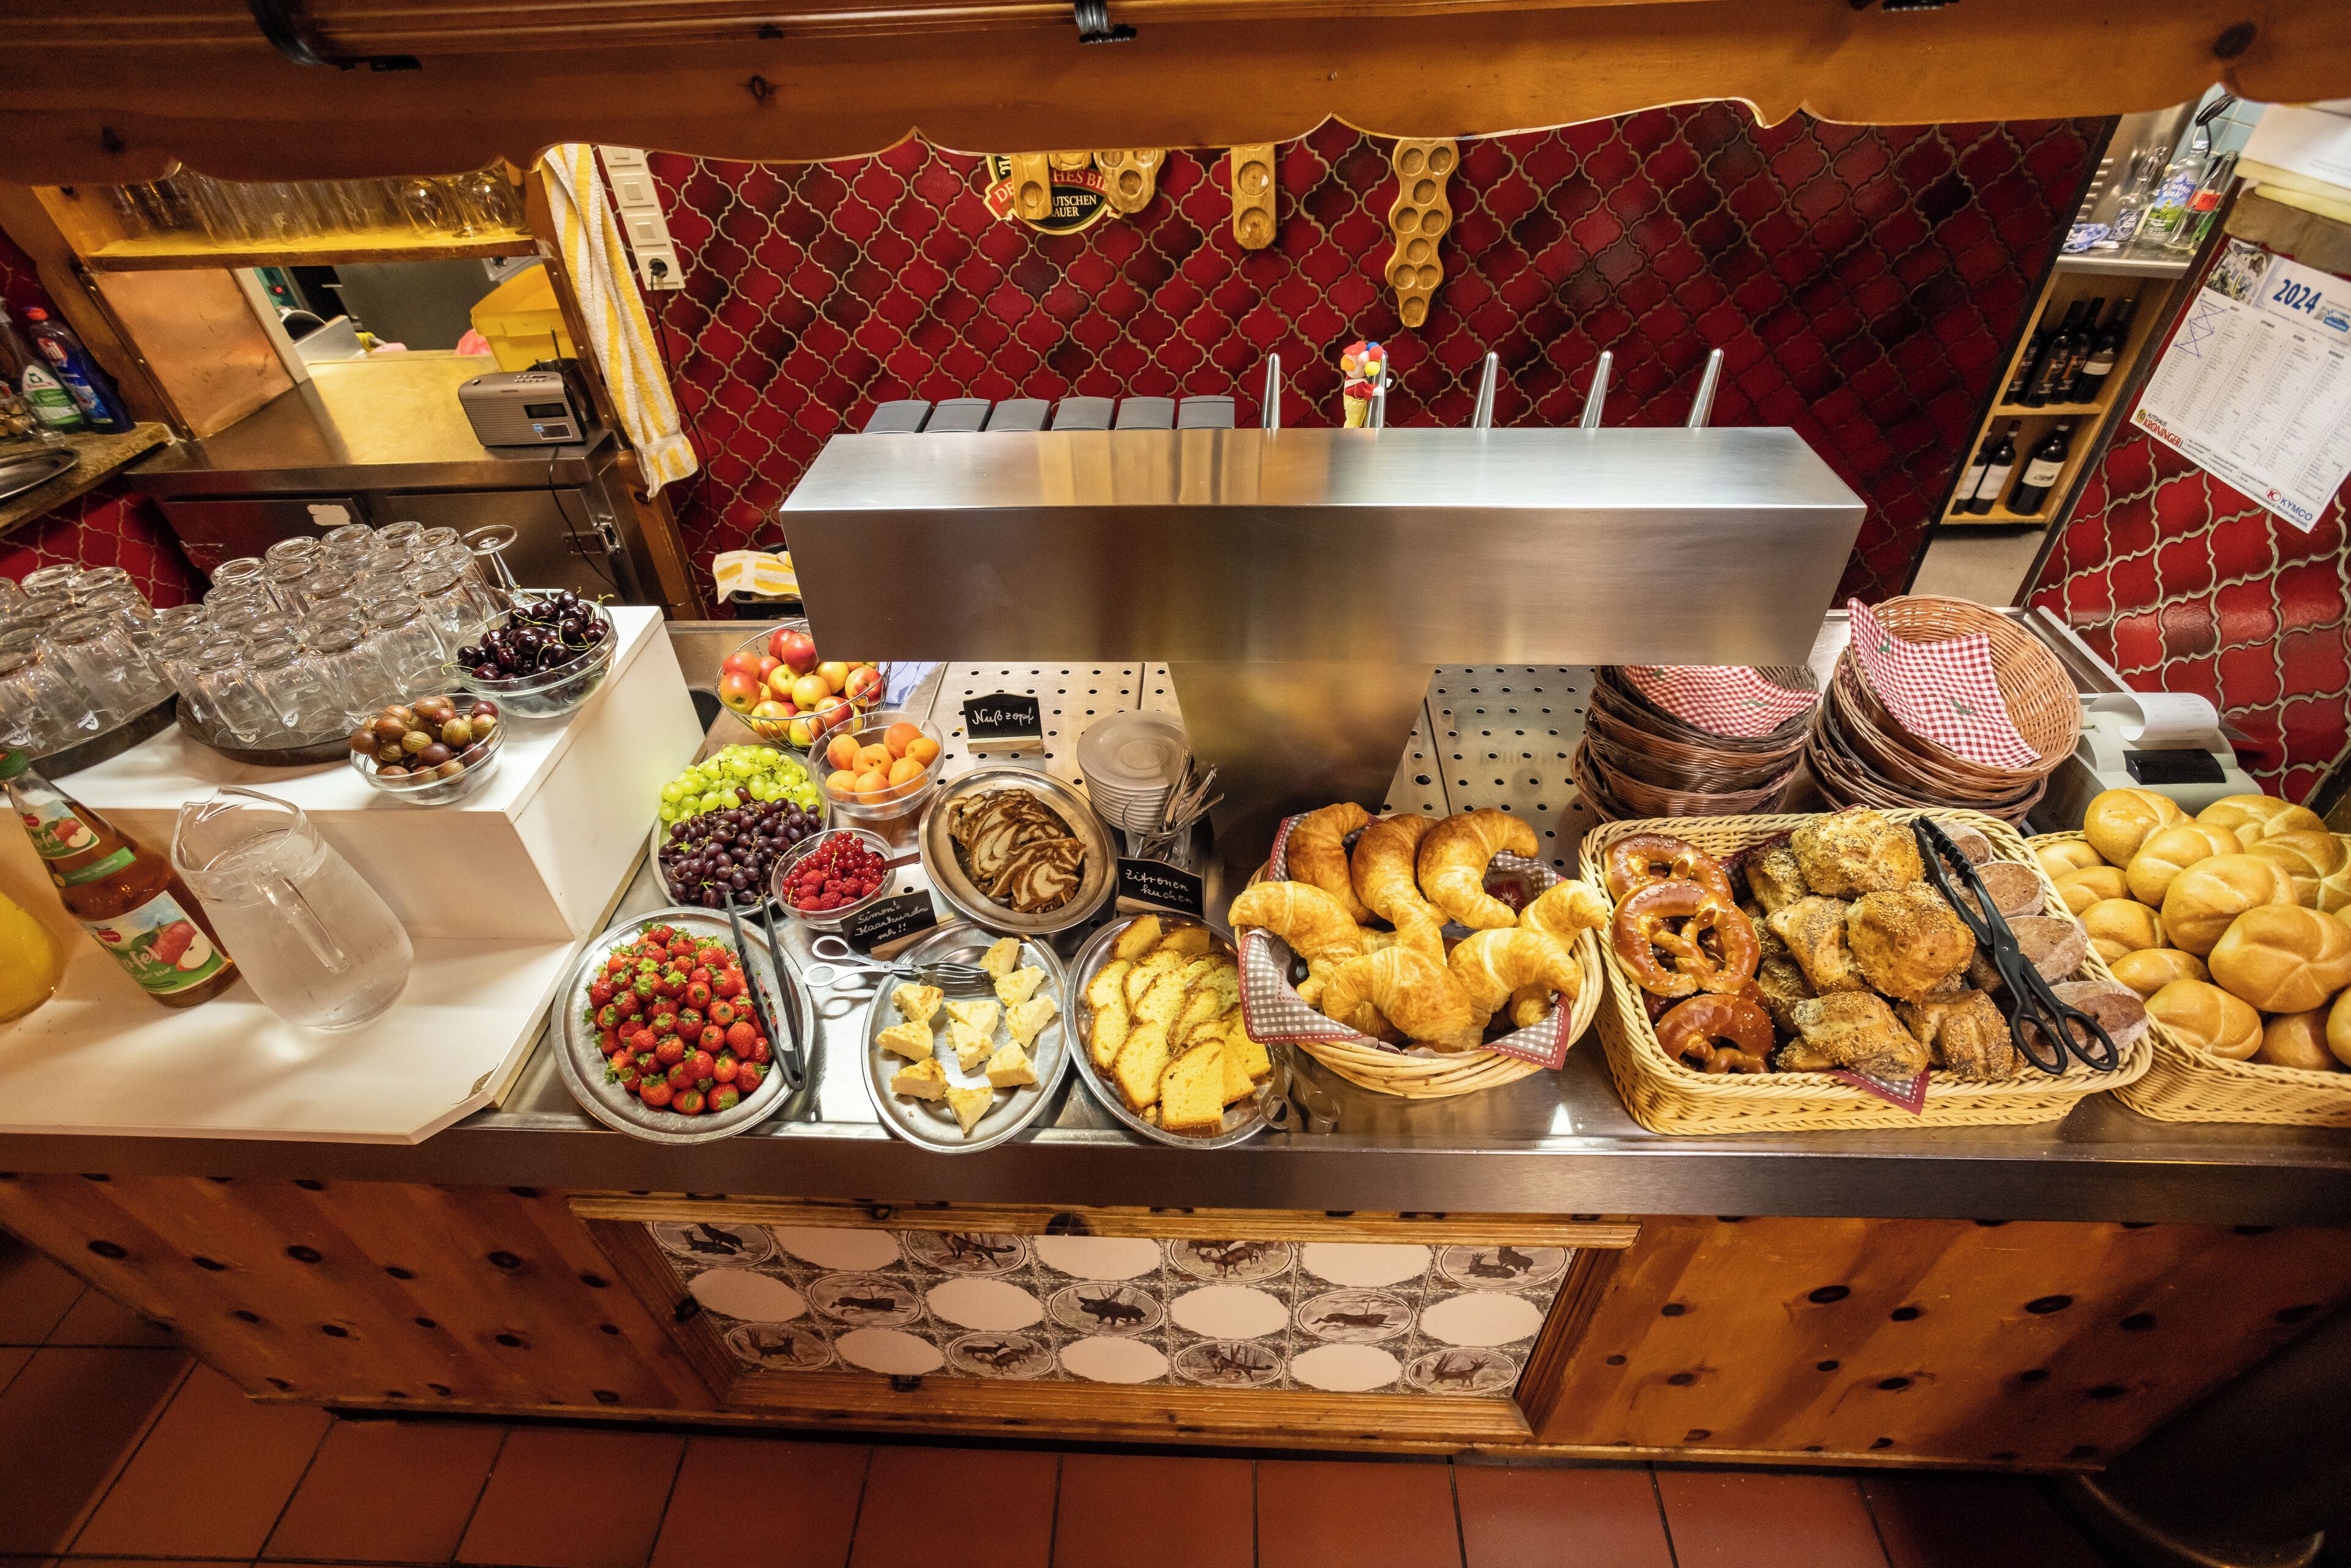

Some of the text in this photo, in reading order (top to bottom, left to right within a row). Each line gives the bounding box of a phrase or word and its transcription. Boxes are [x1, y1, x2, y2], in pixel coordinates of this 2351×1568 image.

[1052, 195, 1097, 206] UTSCHEN
[1052, 206, 1080, 217] AUER
[2272, 279, 2323, 315] 2024
[2147, 413, 2168, 427] AUTOHAUS
[2142, 418, 2182, 447] KRONINGER
[2280, 498, 2313, 521] KYMCO
[1125, 869, 1189, 891] Zitronen
[1141, 884, 1193, 904] kuchen
[858, 900, 902, 924] Simon's
